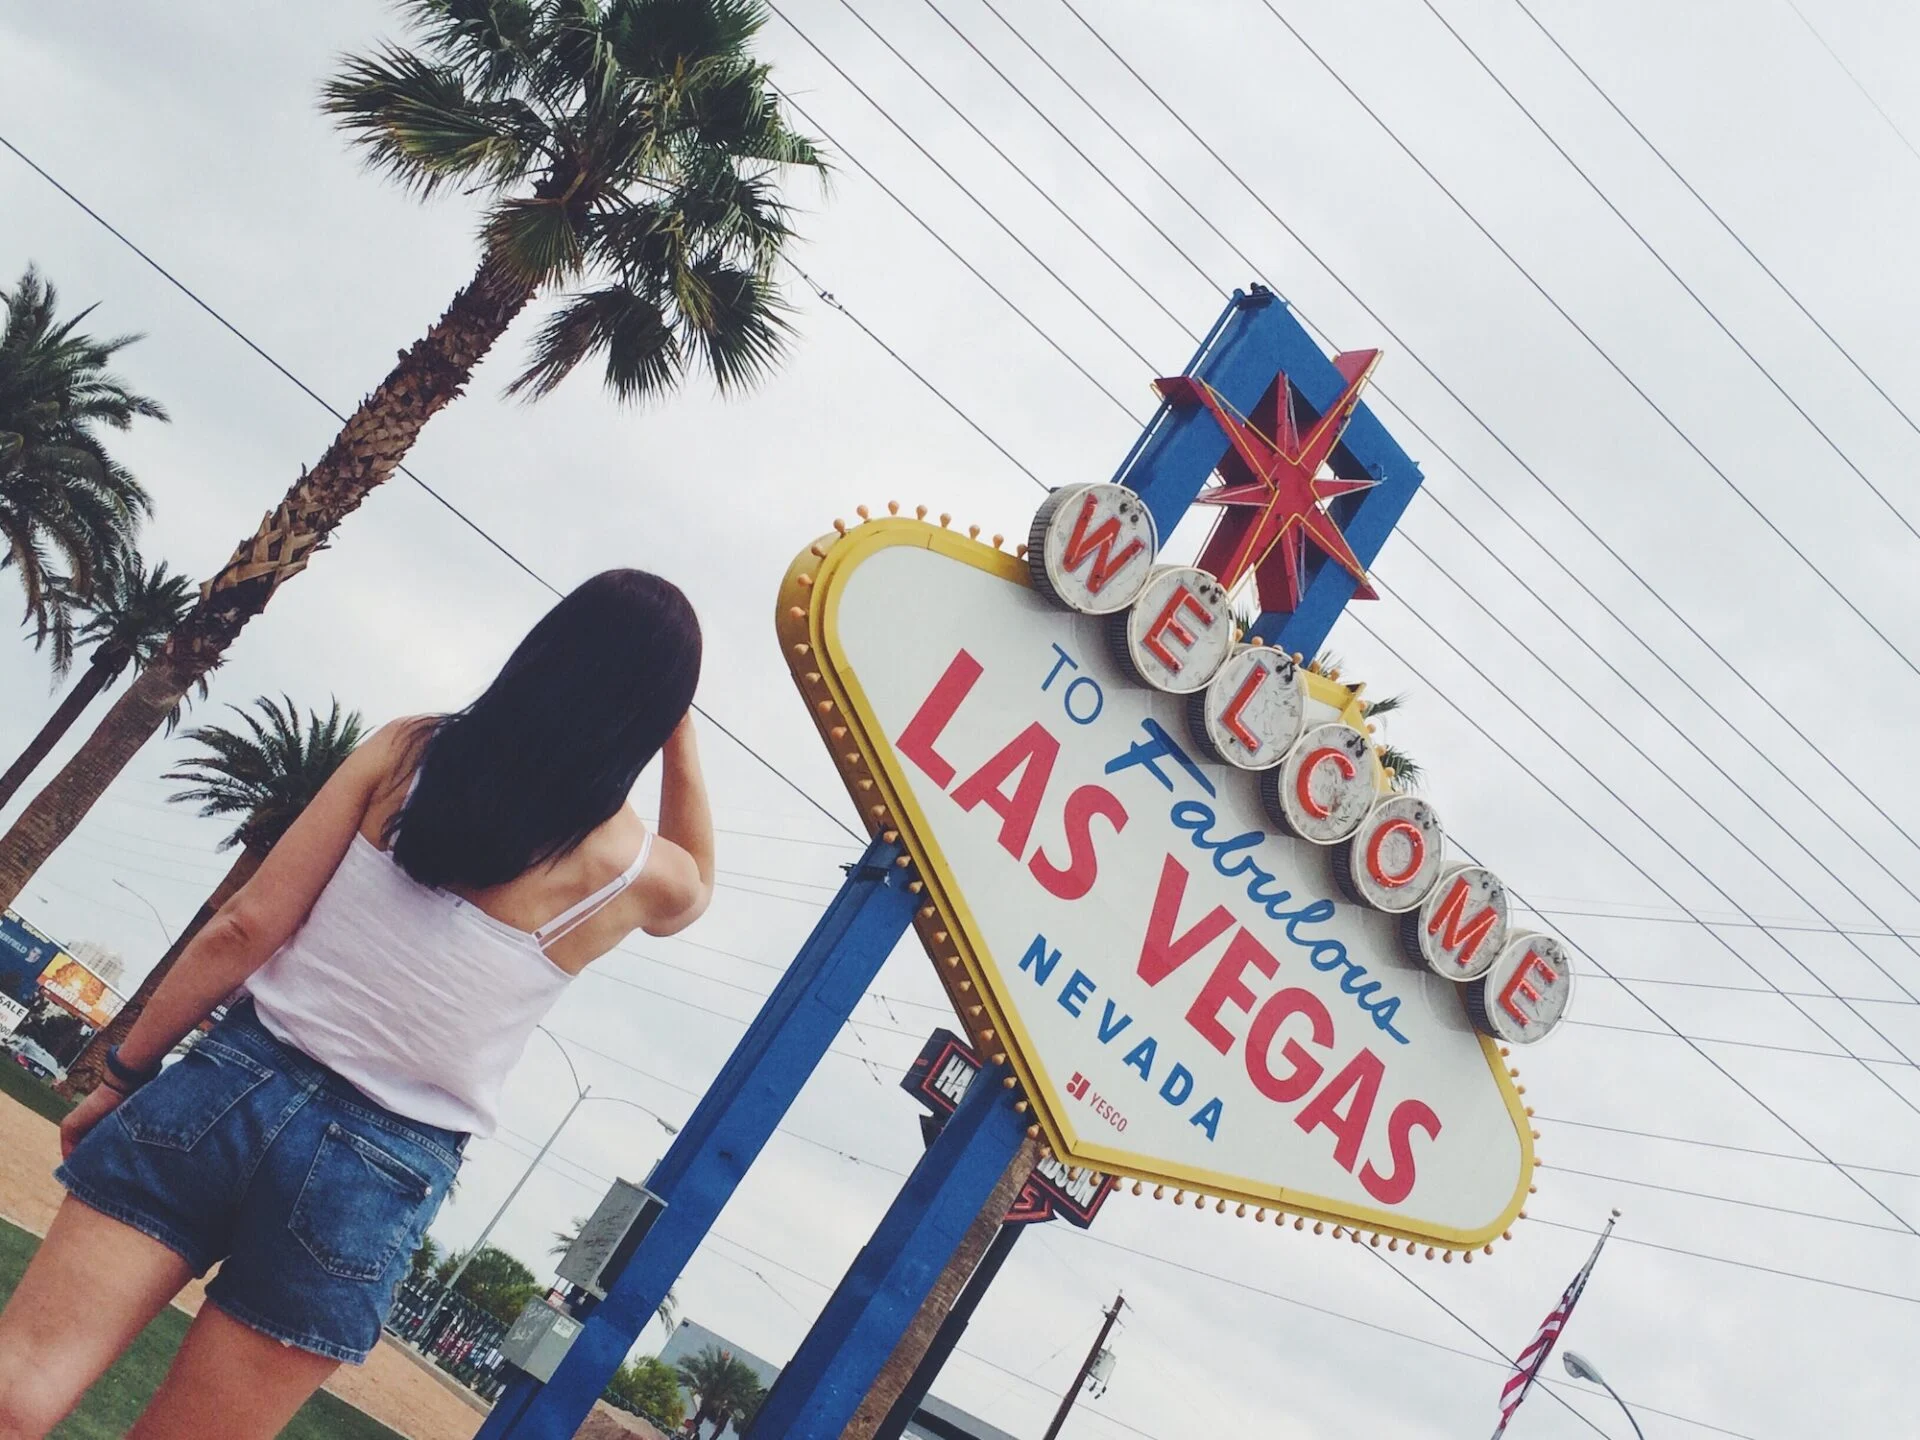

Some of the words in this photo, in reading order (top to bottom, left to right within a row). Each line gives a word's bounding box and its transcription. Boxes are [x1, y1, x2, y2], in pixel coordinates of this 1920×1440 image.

[895, 648, 1129, 900] LAS
[1136, 852, 1442, 1204] VEGAS
[1037, 642, 1104, 725] TO
[1104, 718, 1410, 1044] Fabulous
[1062, 494, 1560, 1027] WELCOME
[1018, 933, 1225, 1141] NEVADA
[1089, 1091, 1128, 1132] YESCO
